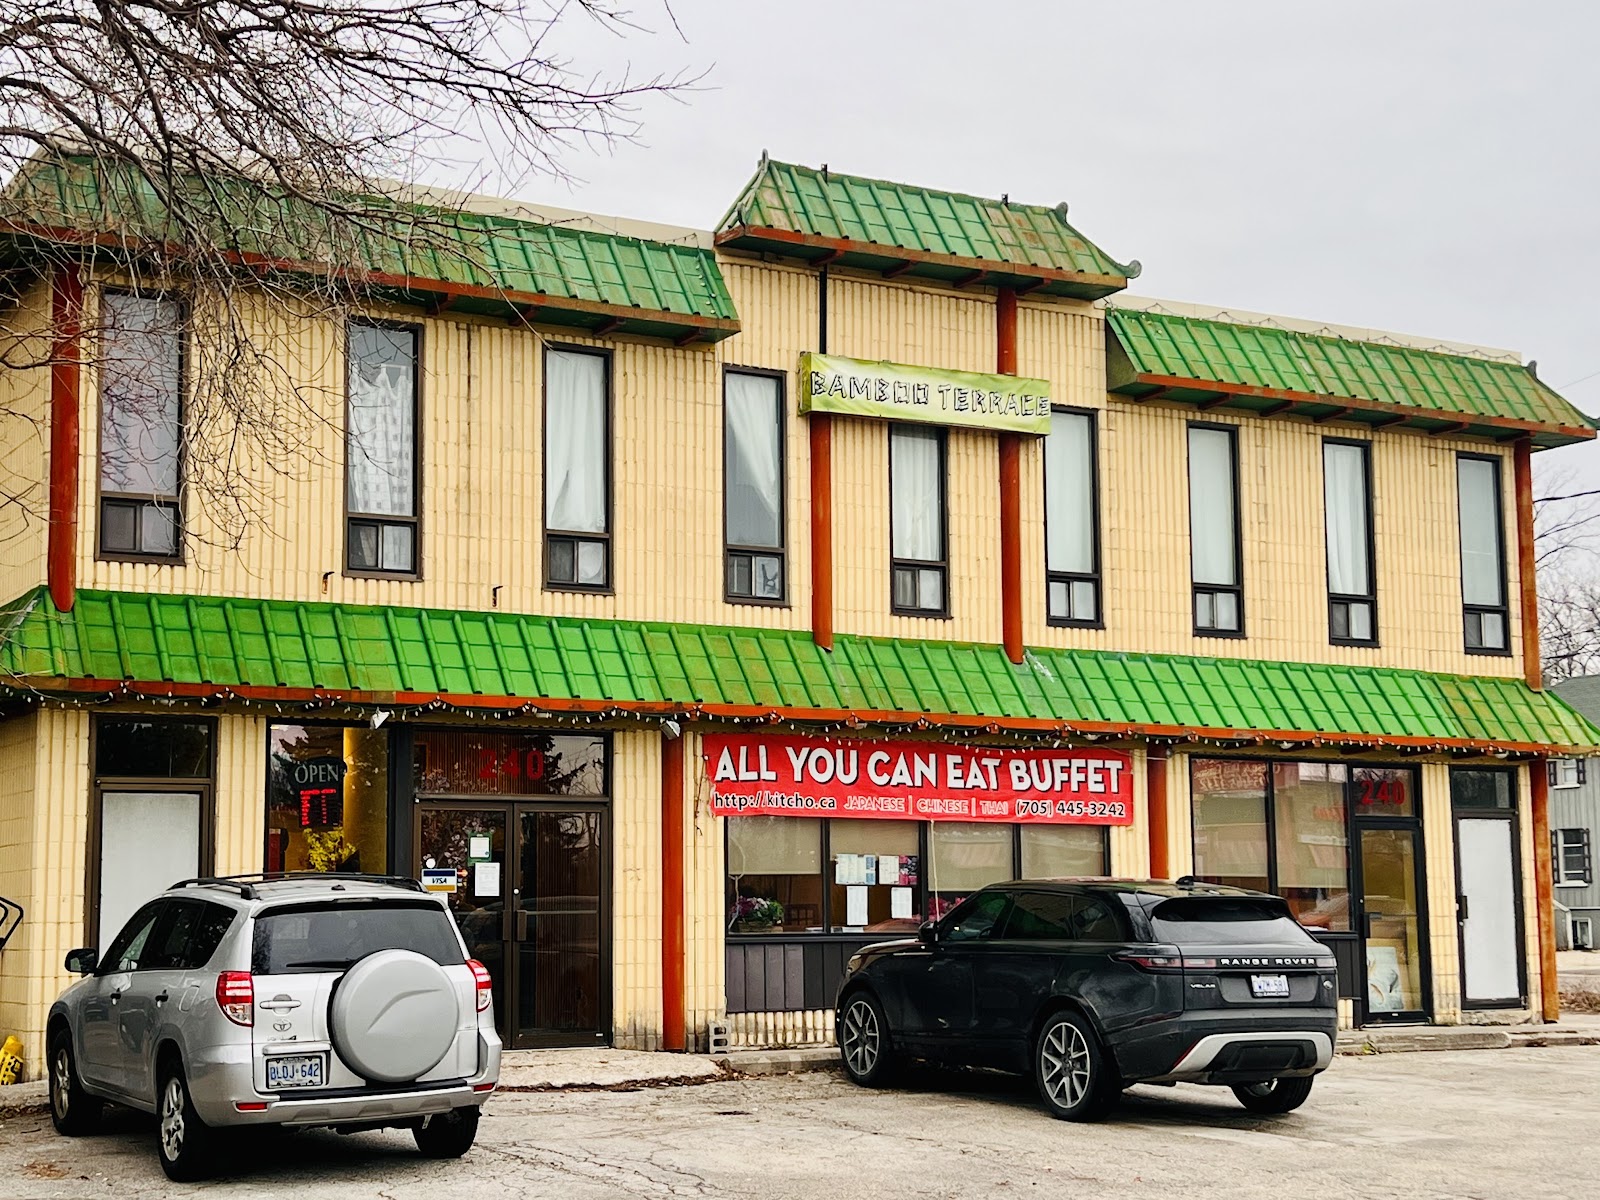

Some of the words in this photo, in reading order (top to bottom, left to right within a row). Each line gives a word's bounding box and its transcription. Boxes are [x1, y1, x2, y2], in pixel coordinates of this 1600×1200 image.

[810, 371, 930, 405] BAMBOO
[938, 383, 1050, 417] TERRACE
[294, 763, 340, 784] OPEN
[479, 749, 544, 780] 240
[714, 744, 777, 782] ALL
[785, 746, 859, 785] YOU
[867, 750, 938, 788] CAN
[946, 754, 1001, 791] EAT
[1009, 759, 1124, 793] BUFFET
[844, 796, 905, 812] JAPANESE
[917, 798, 969, 814] CHINESE
[980, 801, 1009, 815] THAI
[1015, 800, 1053, 817] (705)
[1057, 800, 1125, 817] 445-3242
[1361, 779, 1405, 806] 240
